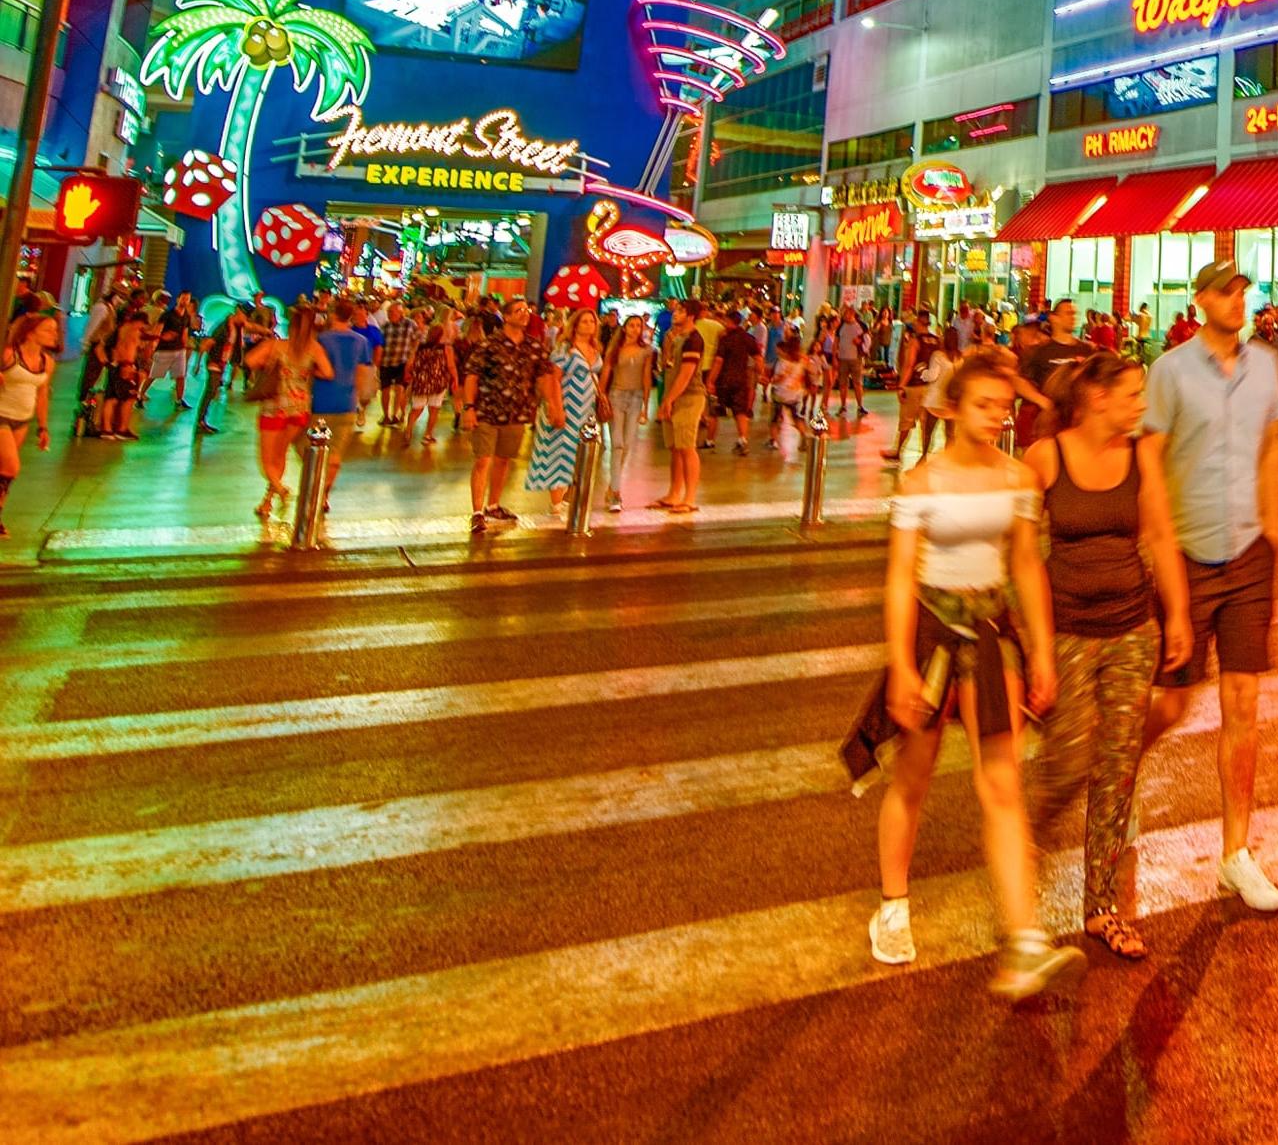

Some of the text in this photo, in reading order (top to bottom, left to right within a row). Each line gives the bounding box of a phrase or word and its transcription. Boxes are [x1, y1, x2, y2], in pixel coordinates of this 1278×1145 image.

[321, 103, 581, 175] Fremont Street
[1085, 125, 1158, 156] PHRMACY
[365, 163, 525, 193] EXPERIENCE
